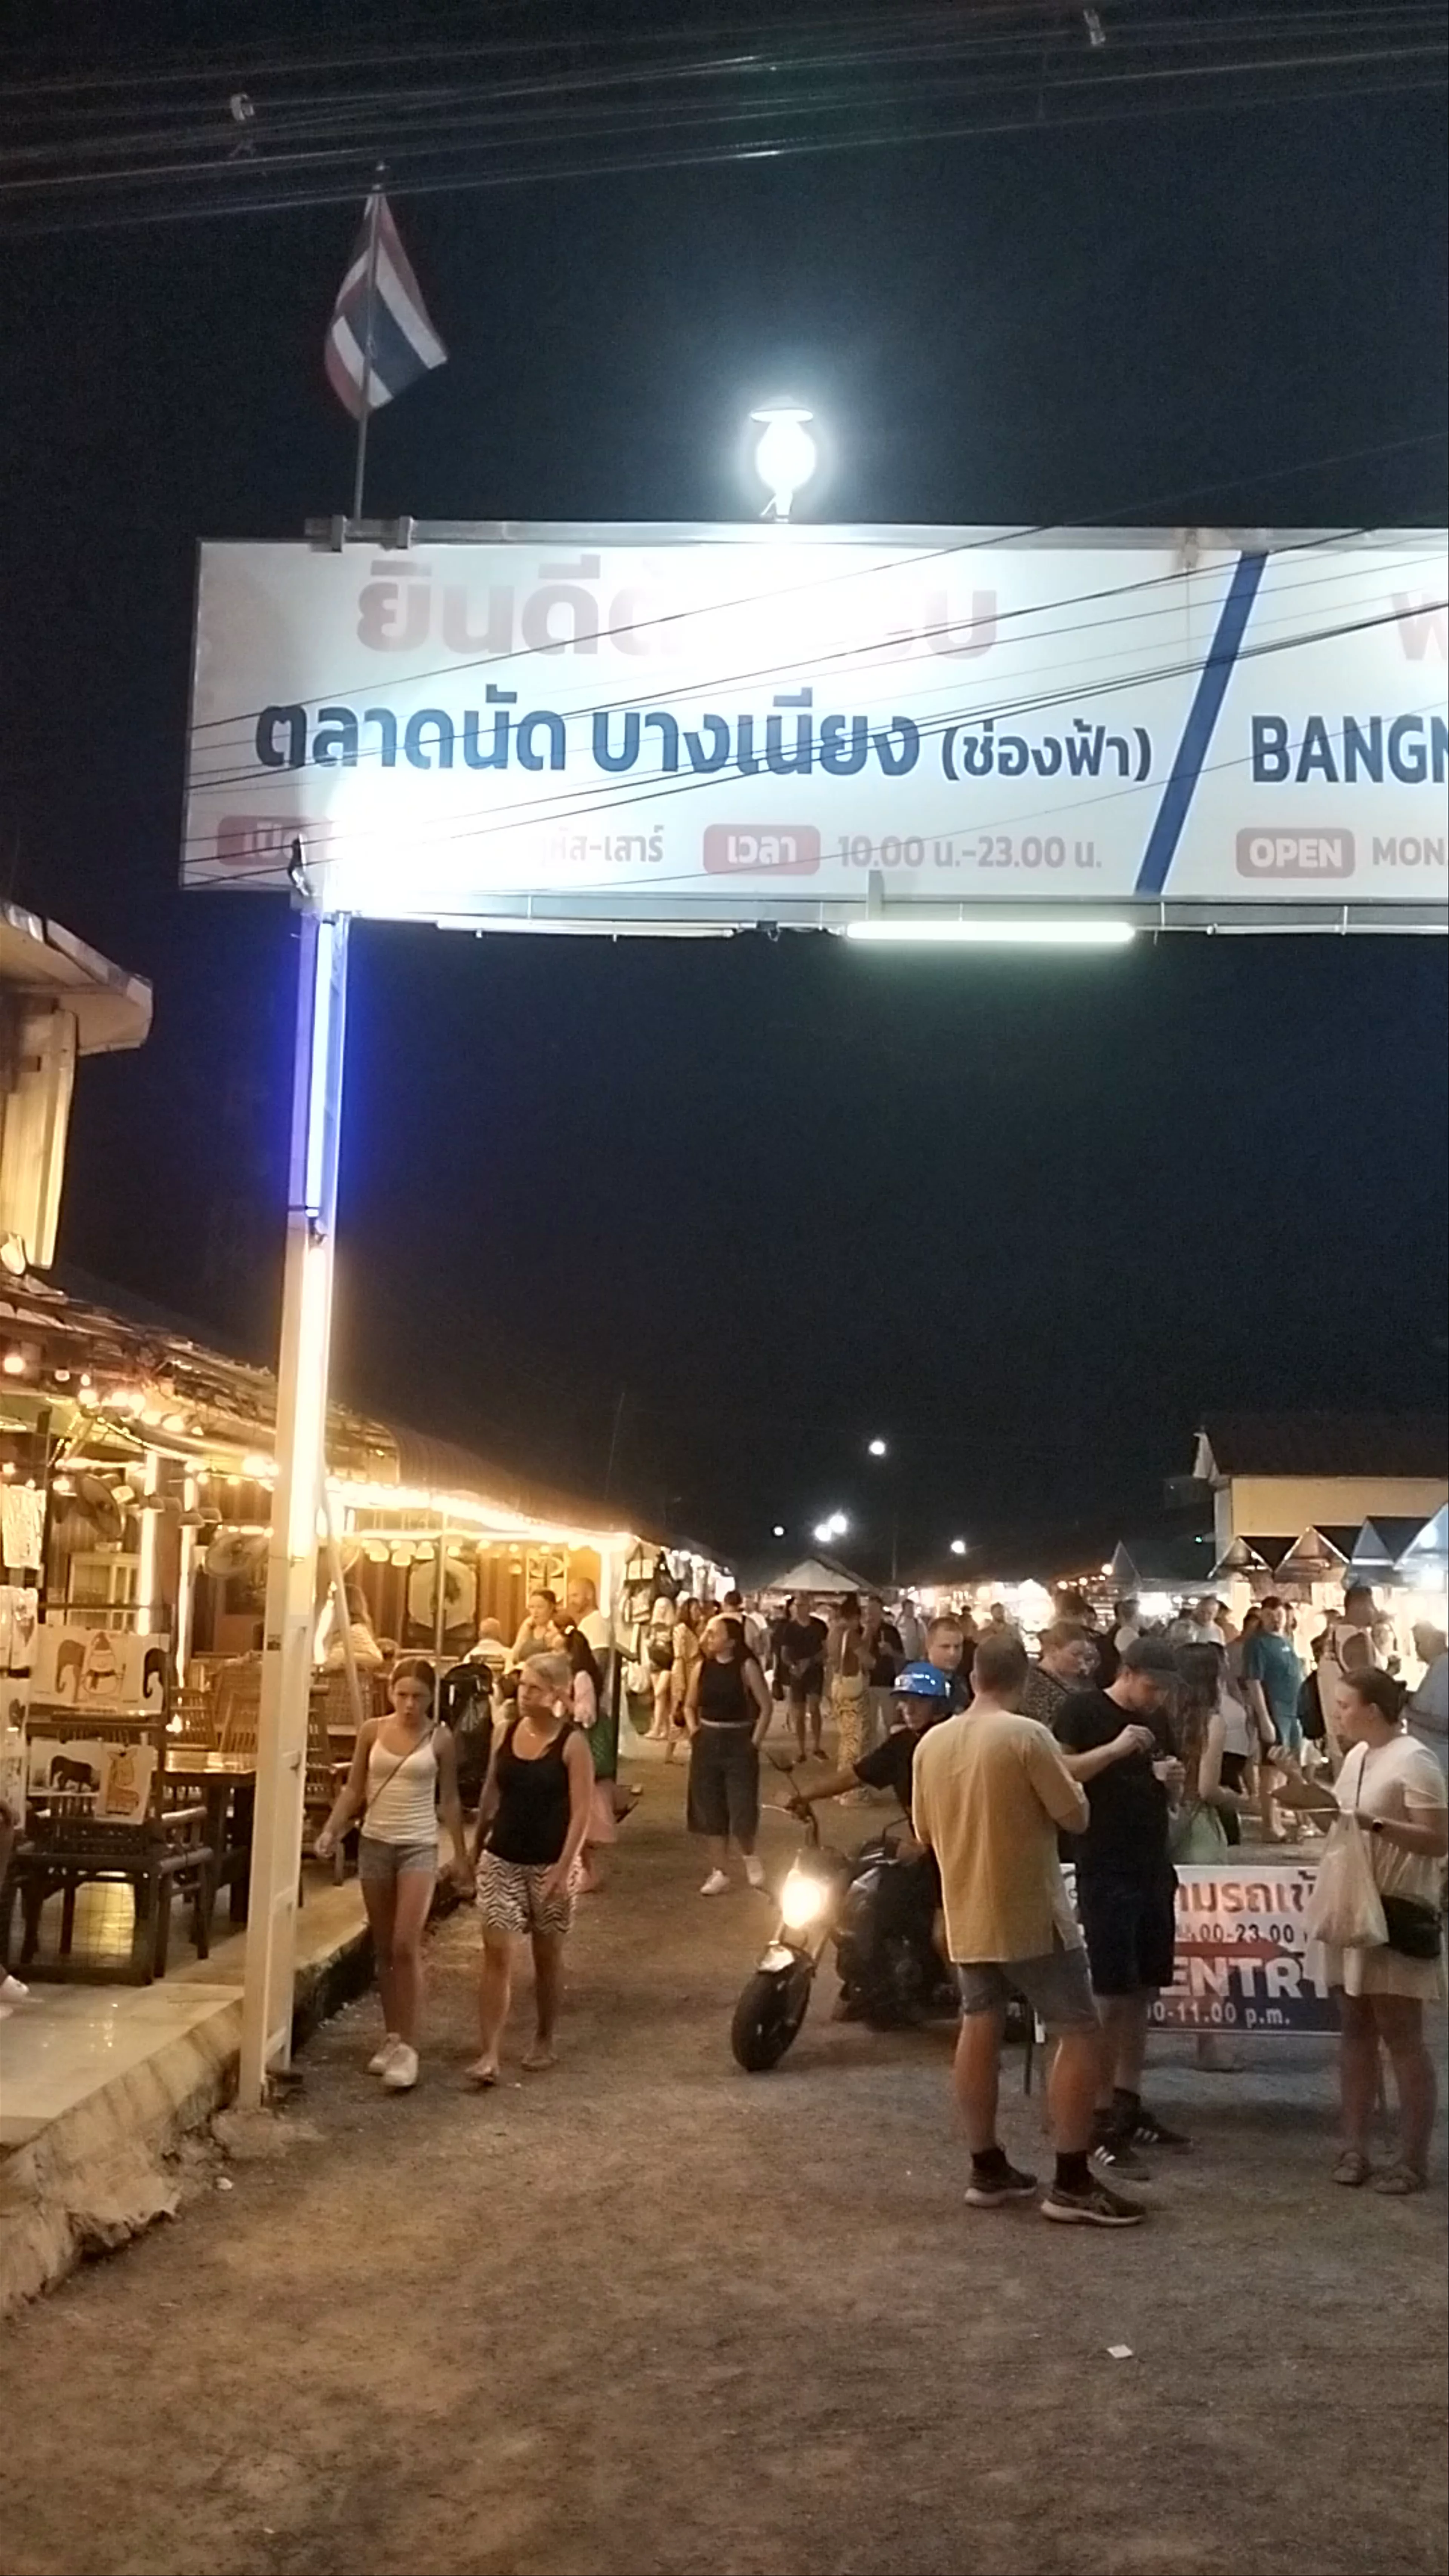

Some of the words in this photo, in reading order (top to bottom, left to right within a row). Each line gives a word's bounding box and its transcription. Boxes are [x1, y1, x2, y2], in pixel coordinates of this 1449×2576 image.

[255, 683, 566, 771] ตลาดนัด
[592, 686, 921, 777] บางเนียง
[942, 718, 1152, 781] (ช่องฟ้า)
[727, 835, 797, 864] เวลา
[838, 836, 925, 867] 10.00
[1074, 841, 1102, 868] น.
[1249, 838, 1342, 867] OPEN
[1245, 2008, 1291, 2029] p.m.
